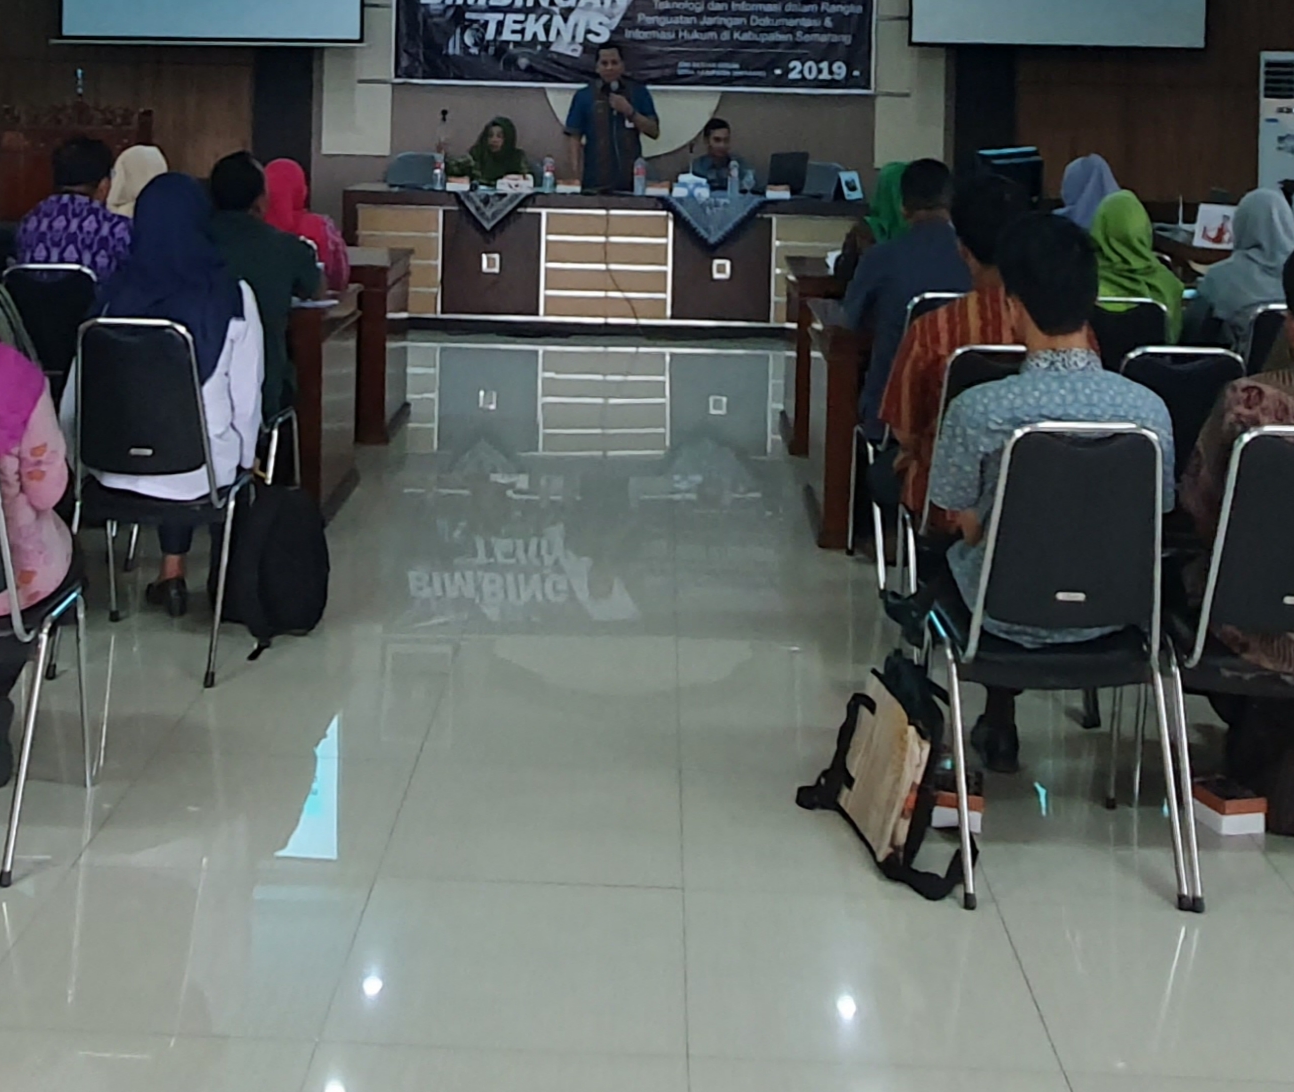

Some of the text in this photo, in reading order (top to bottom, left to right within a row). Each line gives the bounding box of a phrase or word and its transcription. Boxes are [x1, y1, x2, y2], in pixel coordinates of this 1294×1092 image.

[652, 0, 704, 13] Teknologi
[707, 1, 728, 11] dan
[731, 1, 782, 12] Informasi
[468, 12, 611, 43] TEKNIS
[637, 13, 697, 26] Penguatan
[699, 15, 747, 28] Jaringan
[749, 15, 822, 27] Dokumentasi
[625, 29, 852, 45] Informasi Hukum di Kabupaten Semarang
[787, 60, 847, 80] 2019
